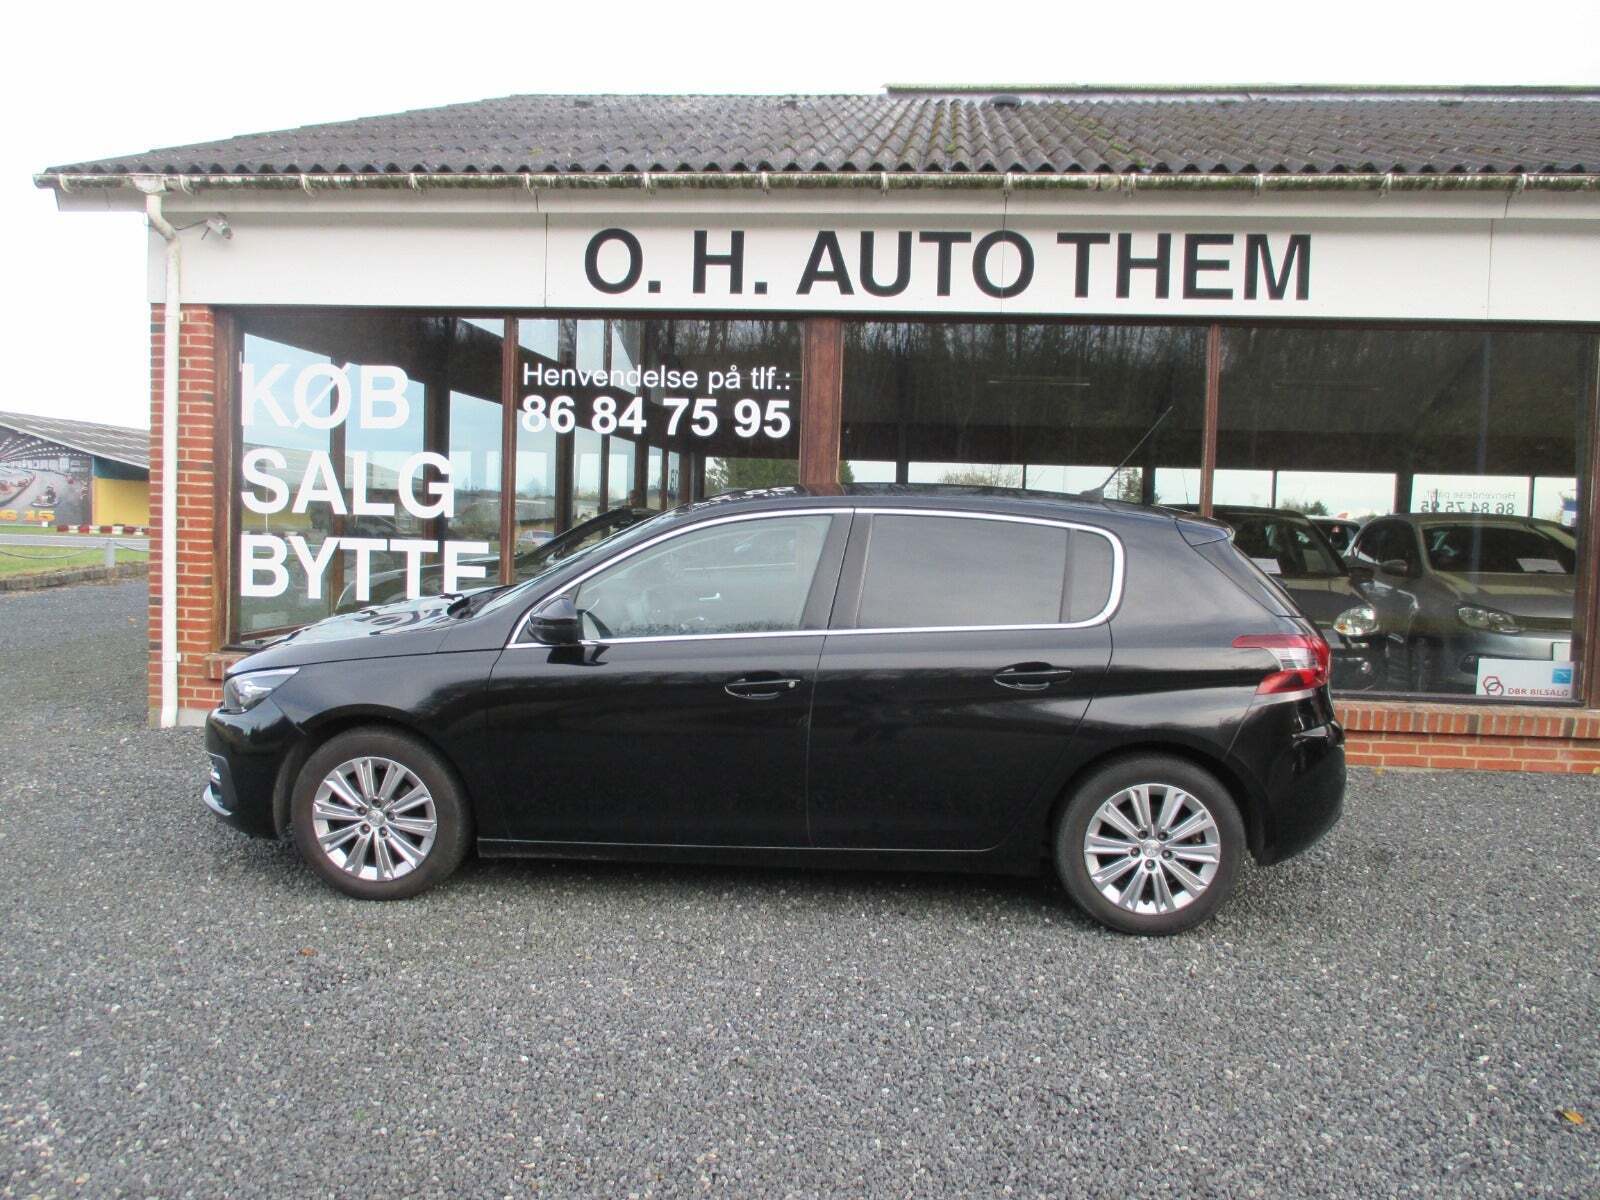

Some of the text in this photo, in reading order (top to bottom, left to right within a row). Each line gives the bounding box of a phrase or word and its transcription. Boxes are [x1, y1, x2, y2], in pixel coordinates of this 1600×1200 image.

[585, 228, 1311, 300] O. H. AUTO THEM
[241, 362, 410, 429] KØB
[523, 363, 790, 394] Henvendelse på tlf.:
[521, 395, 791, 438] 86 84 75 95
[241, 449, 455, 518] SALG
[240, 534, 489, 601] BYTTE
[1508, 687, 1569, 697] DBR BILSALG
